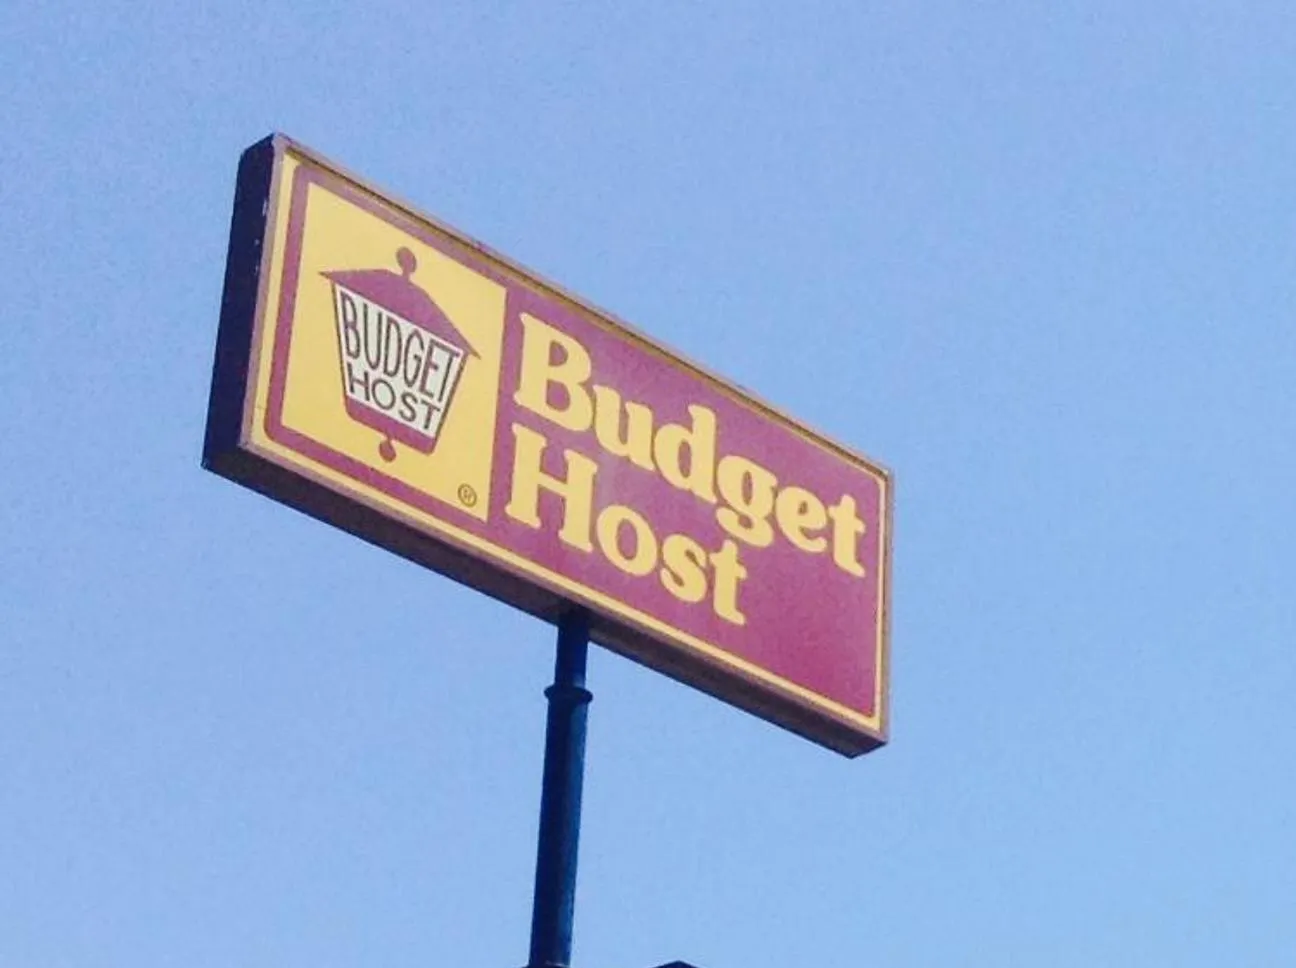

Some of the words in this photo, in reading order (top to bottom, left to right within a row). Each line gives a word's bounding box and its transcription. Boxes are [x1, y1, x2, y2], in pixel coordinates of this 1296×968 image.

[340, 289, 462, 403] BUDGET
[346, 362, 441, 430] HOST
[511, 310, 866, 578] Budget
[505, 423, 745, 625] Host
